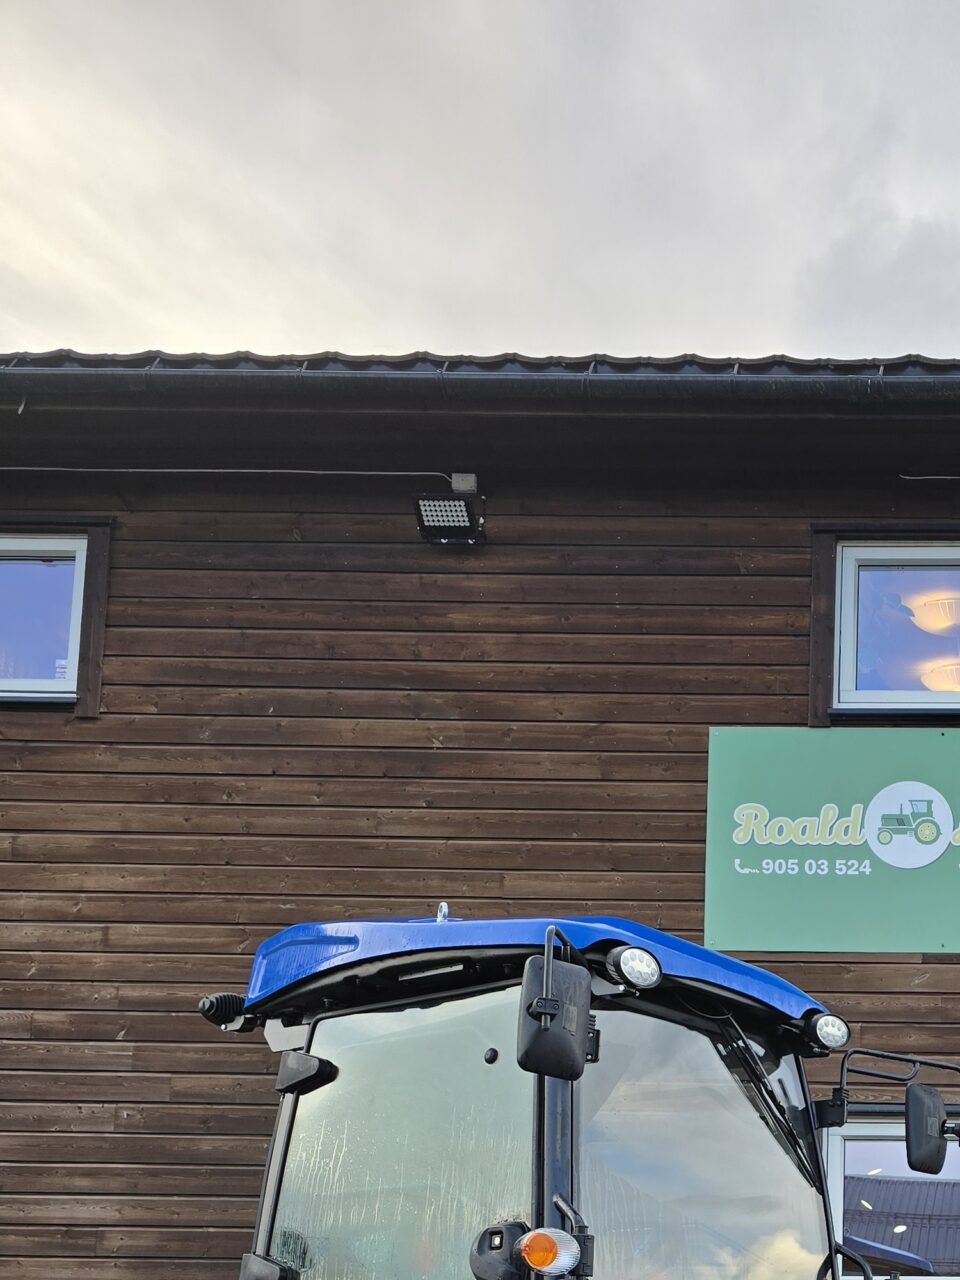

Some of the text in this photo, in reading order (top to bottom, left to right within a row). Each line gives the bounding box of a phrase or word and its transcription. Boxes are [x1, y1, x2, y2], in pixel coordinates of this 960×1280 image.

[733, 803, 867, 846] Roald
[762, 859, 872, 875] 905 03 524
